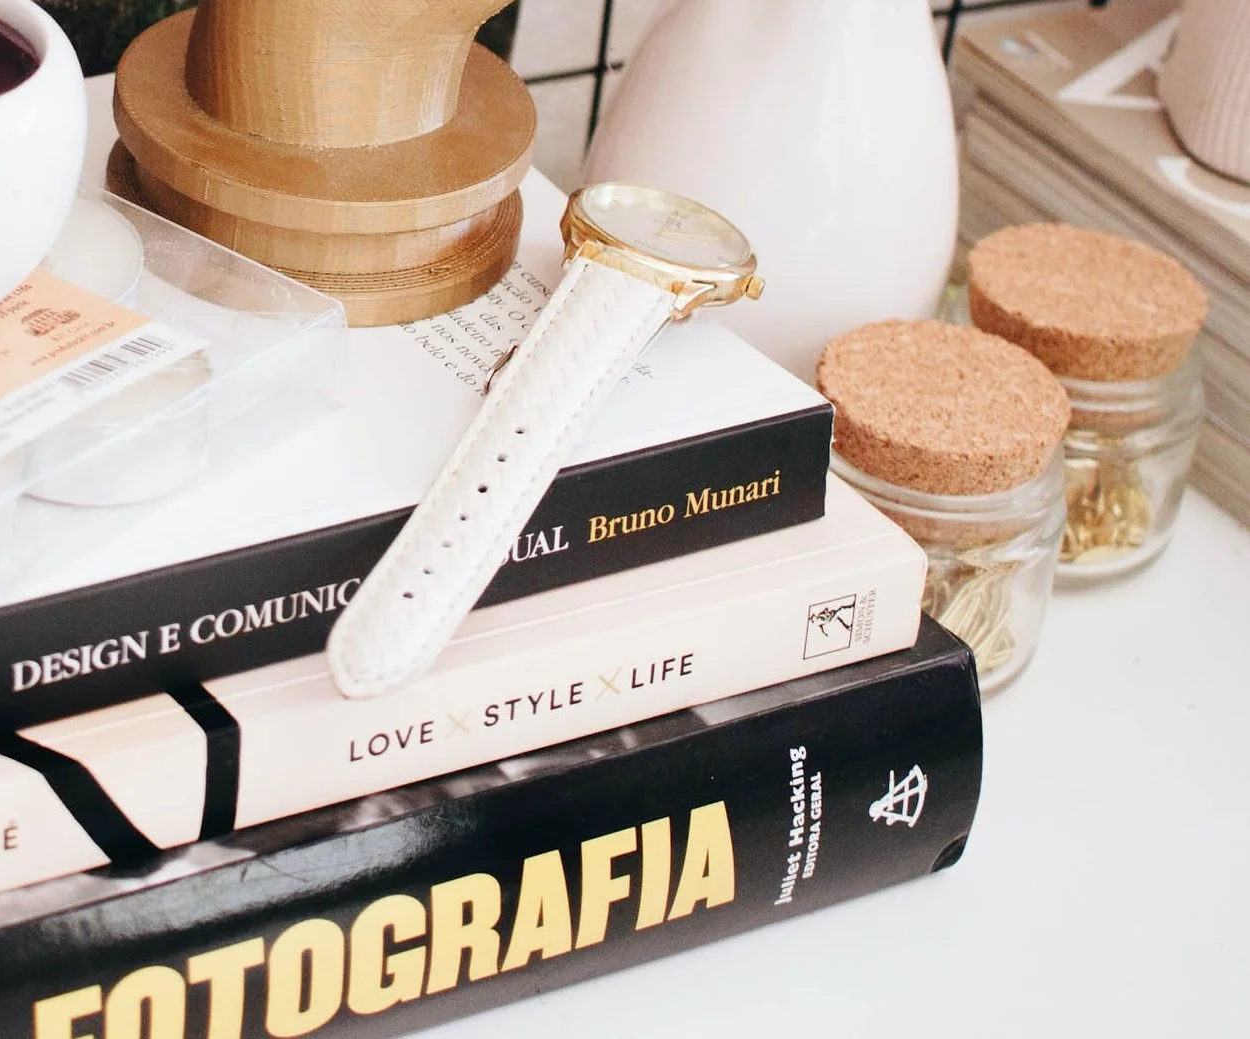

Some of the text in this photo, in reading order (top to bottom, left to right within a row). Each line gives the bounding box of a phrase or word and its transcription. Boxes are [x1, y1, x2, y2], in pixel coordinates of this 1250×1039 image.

[12, 470, 782, 692] DESIGN E COMUNIC UAL Bruno Munari
[350, 719, 436, 764] LOVE
[483, 681, 584, 728] STYLE
[630, 652, 695, 690] LIFE
[773, 745, 808, 906] Juliet Hacking
[802, 771, 823, 879] EDITORA GERAL
